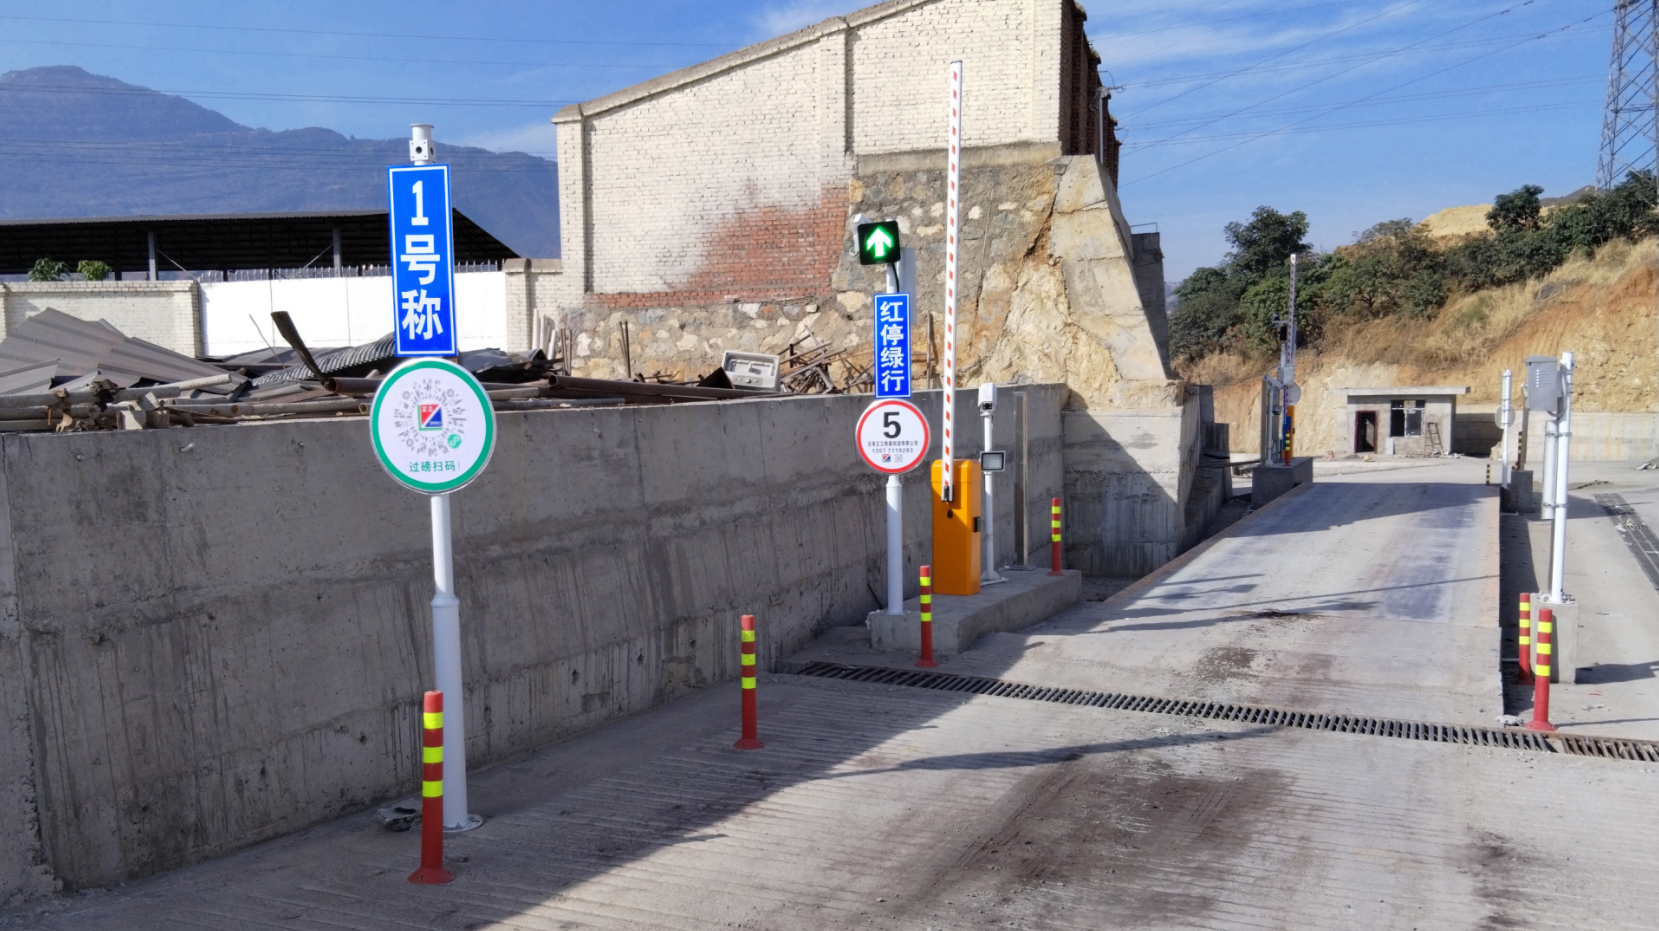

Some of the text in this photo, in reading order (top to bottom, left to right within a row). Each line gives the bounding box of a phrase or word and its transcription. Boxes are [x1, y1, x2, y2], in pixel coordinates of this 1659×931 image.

[400, 180, 443, 340] 1号称
[880, 301, 905, 392] 红停绿行
[883, 411, 902, 439] 5
